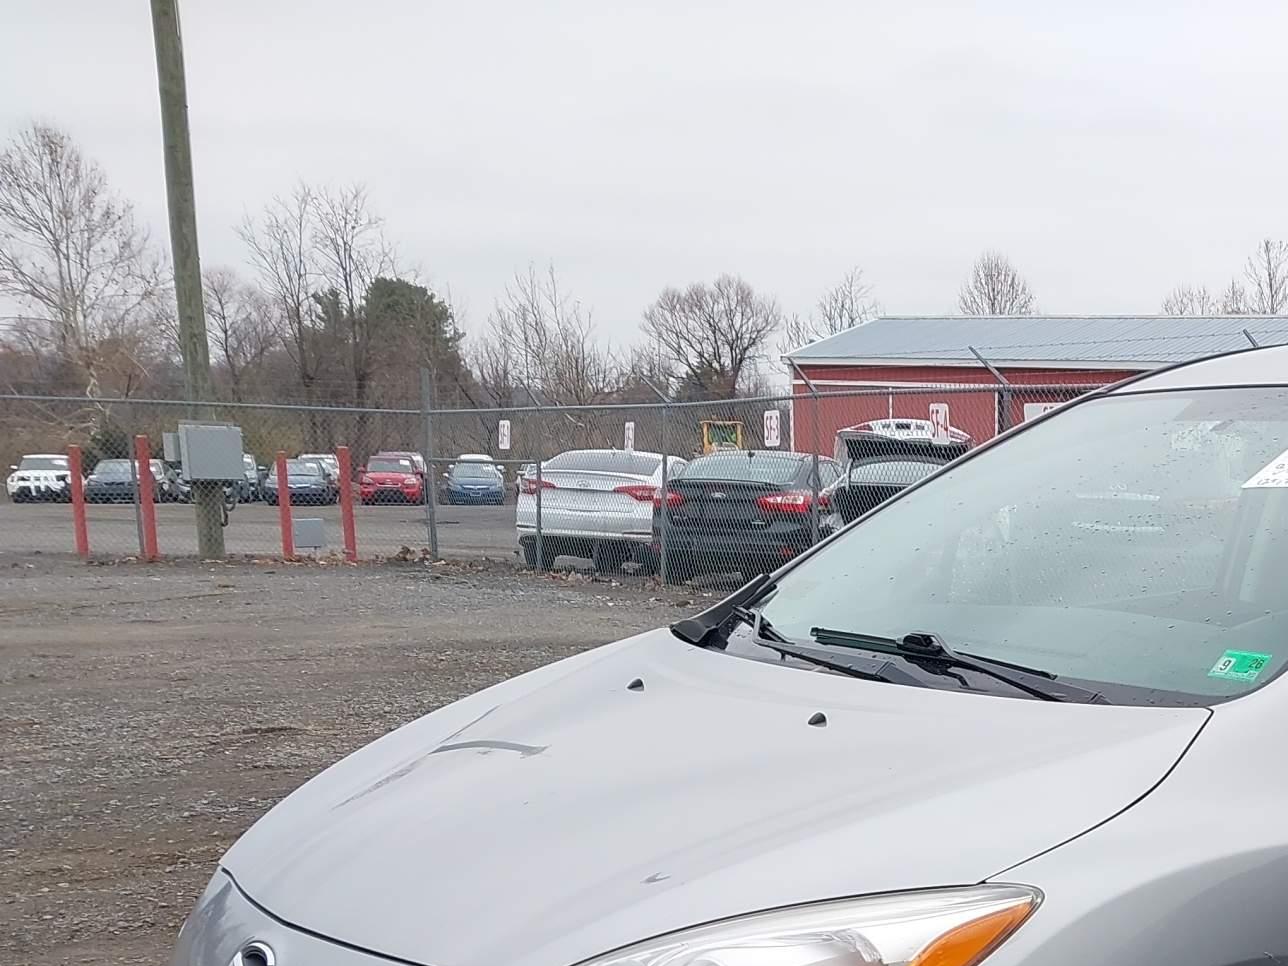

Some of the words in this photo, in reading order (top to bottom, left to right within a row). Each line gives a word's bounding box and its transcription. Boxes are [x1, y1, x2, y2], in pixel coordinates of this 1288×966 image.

[765, 414, 779, 441] SF-3
[930, 408, 949, 439] SF-4
[1219, 659, 1232, 671] 9
[1248, 658, 1265, 669] 26
